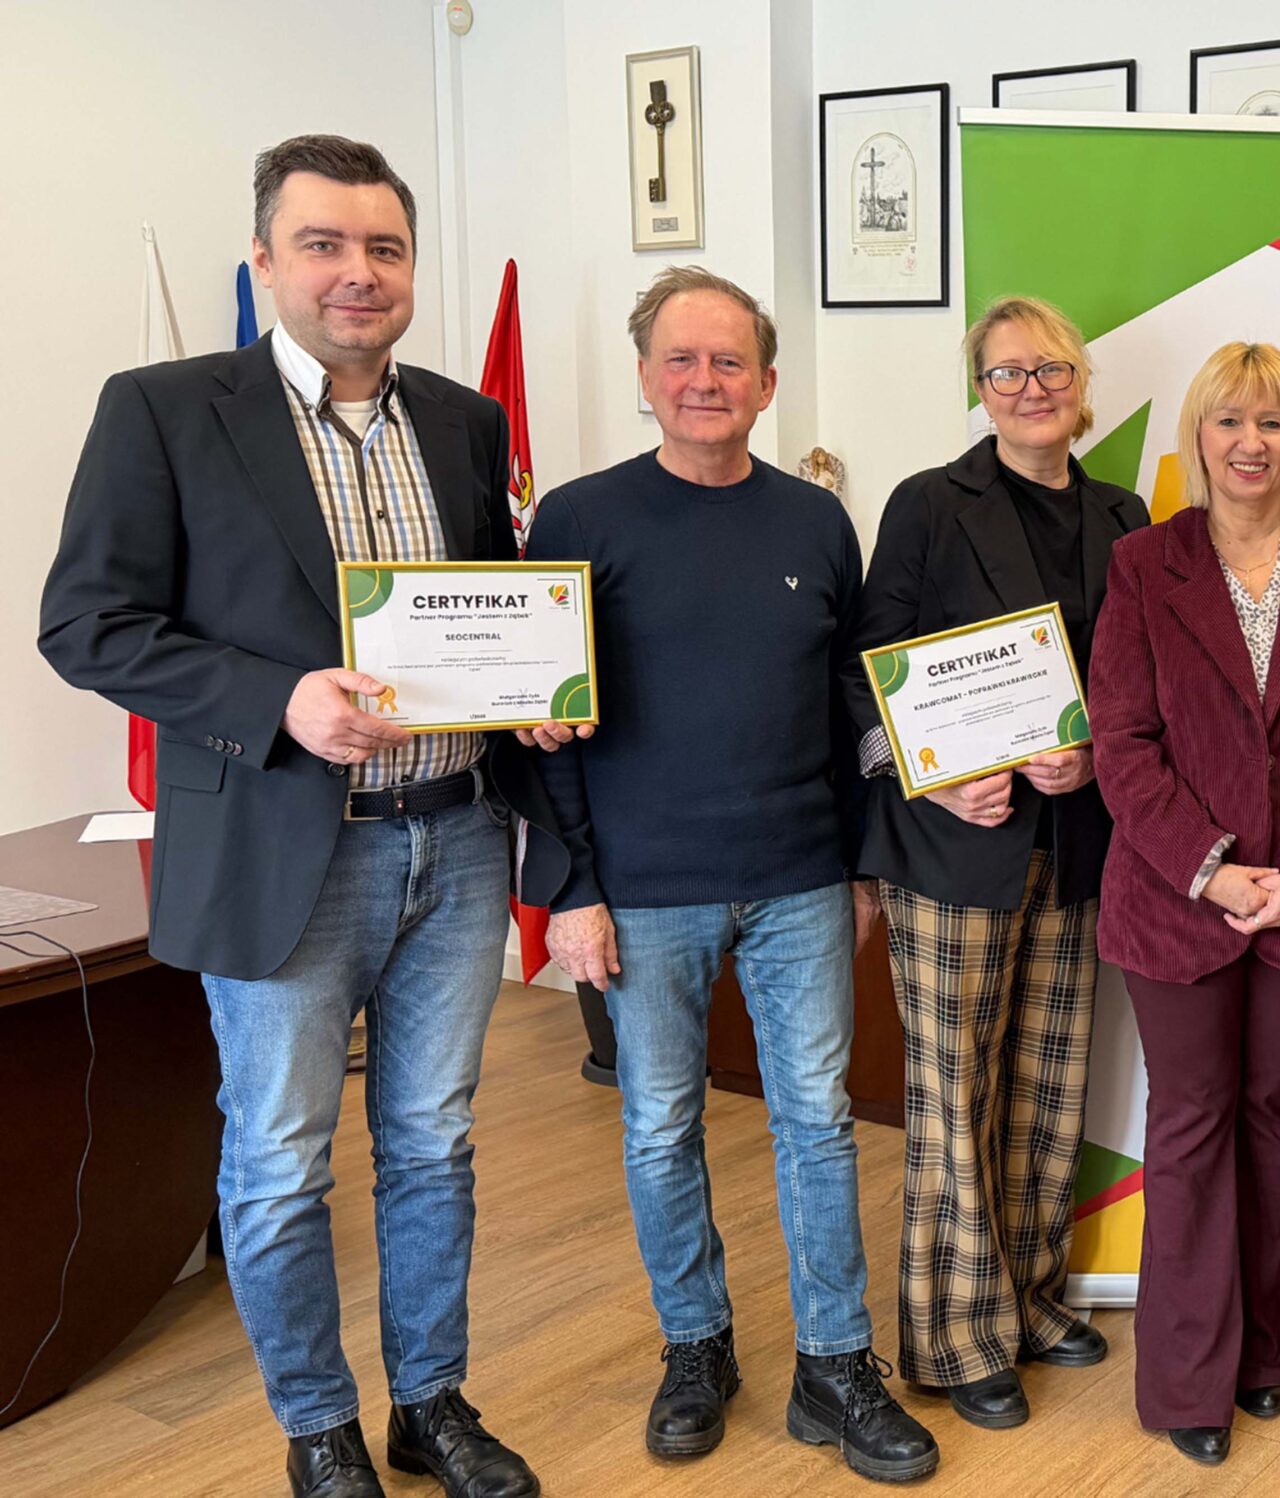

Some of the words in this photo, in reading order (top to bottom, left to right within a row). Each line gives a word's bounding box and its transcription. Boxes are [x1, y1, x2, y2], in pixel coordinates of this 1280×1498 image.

[412, 594, 529, 609] CERTYFIKAT
[437, 613, 473, 622] Programu
[445, 633, 502, 641] SEOCENTRAL
[926, 643, 1017, 677] CERTYFIKAT
[913, 693, 963, 711] KRAWCOMAT
[968, 681, 1006, 696] POPRAWKI
[1006, 669, 1048, 686] KRAWIECKIE
